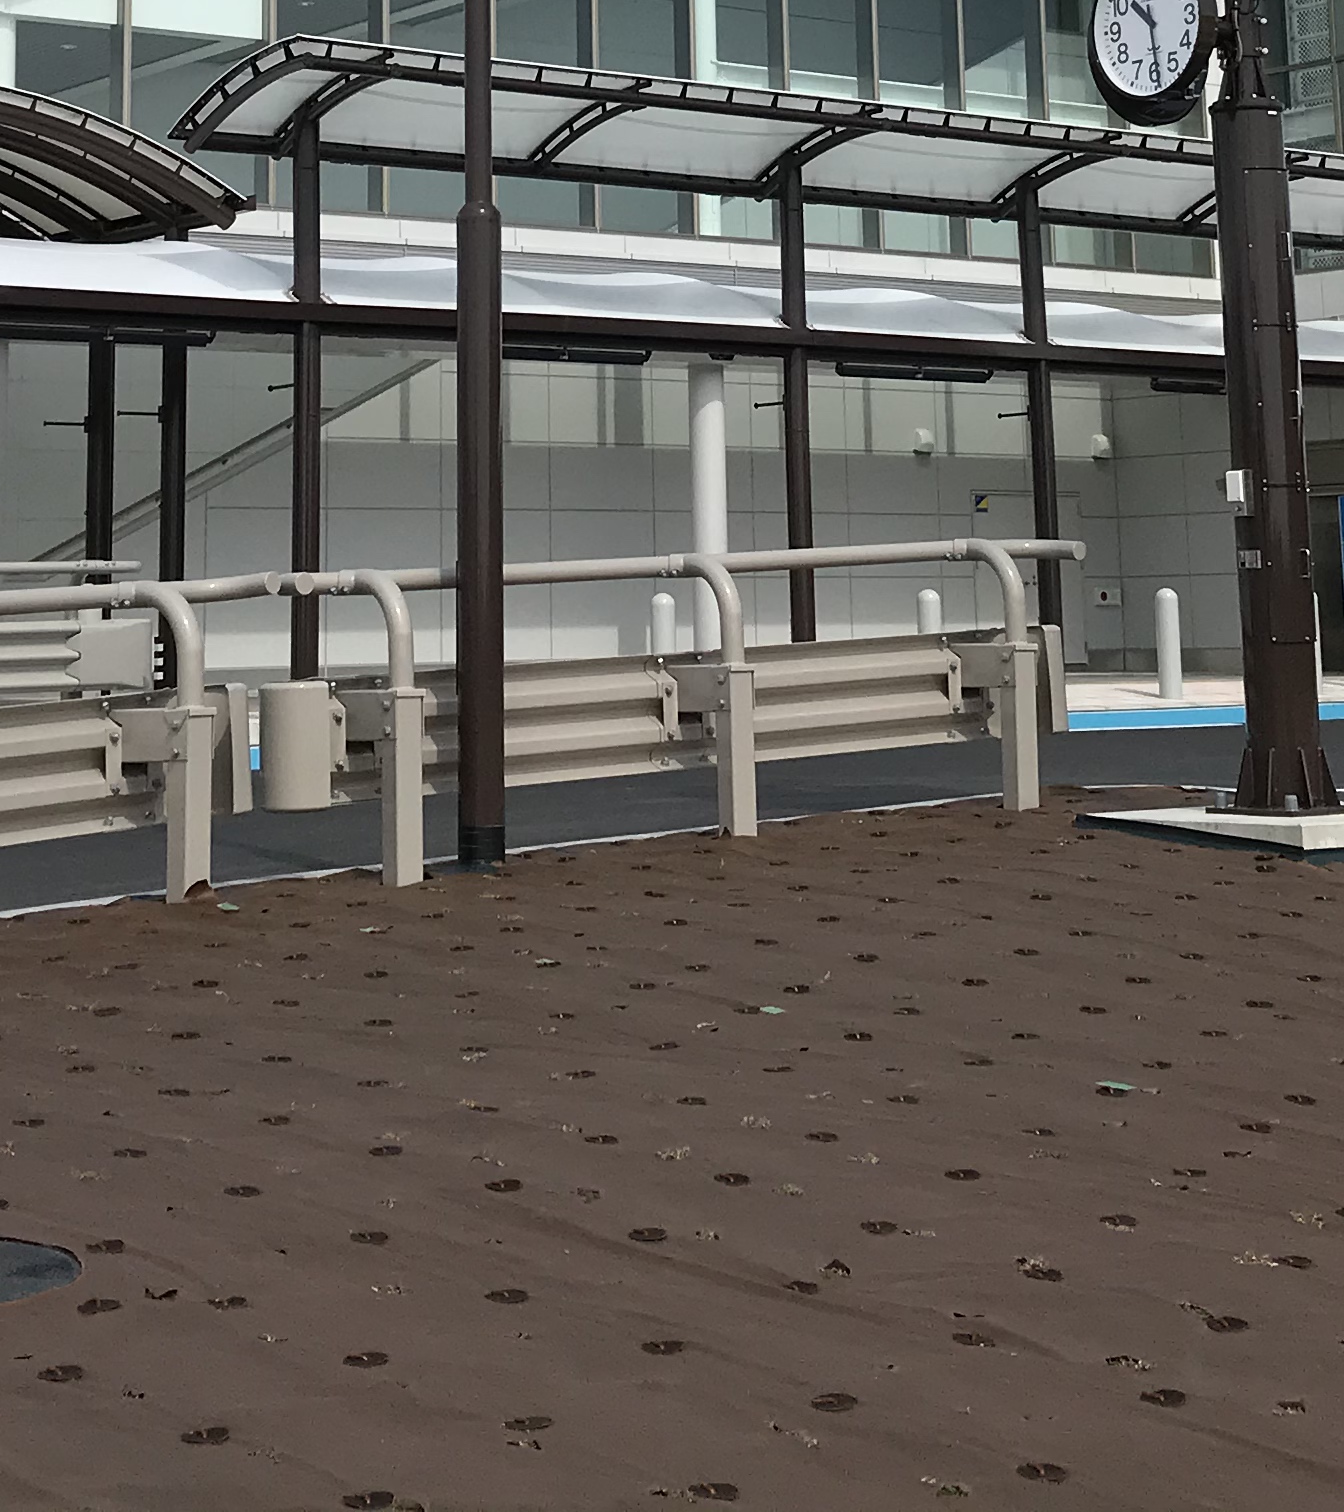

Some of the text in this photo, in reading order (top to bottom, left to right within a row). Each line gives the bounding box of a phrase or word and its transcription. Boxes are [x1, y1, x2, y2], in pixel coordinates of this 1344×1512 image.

[1183, 3, 1196, 25] 3
[1109, 21, 1122, 43] 9
[1179, 29, 1192, 50] 4
[1117, 43, 1129, 64] 8
[1167, 51, 1179, 73] 5
[1131, 59, 1144, 81] 7
[1148, 61, 1161, 84] 6
